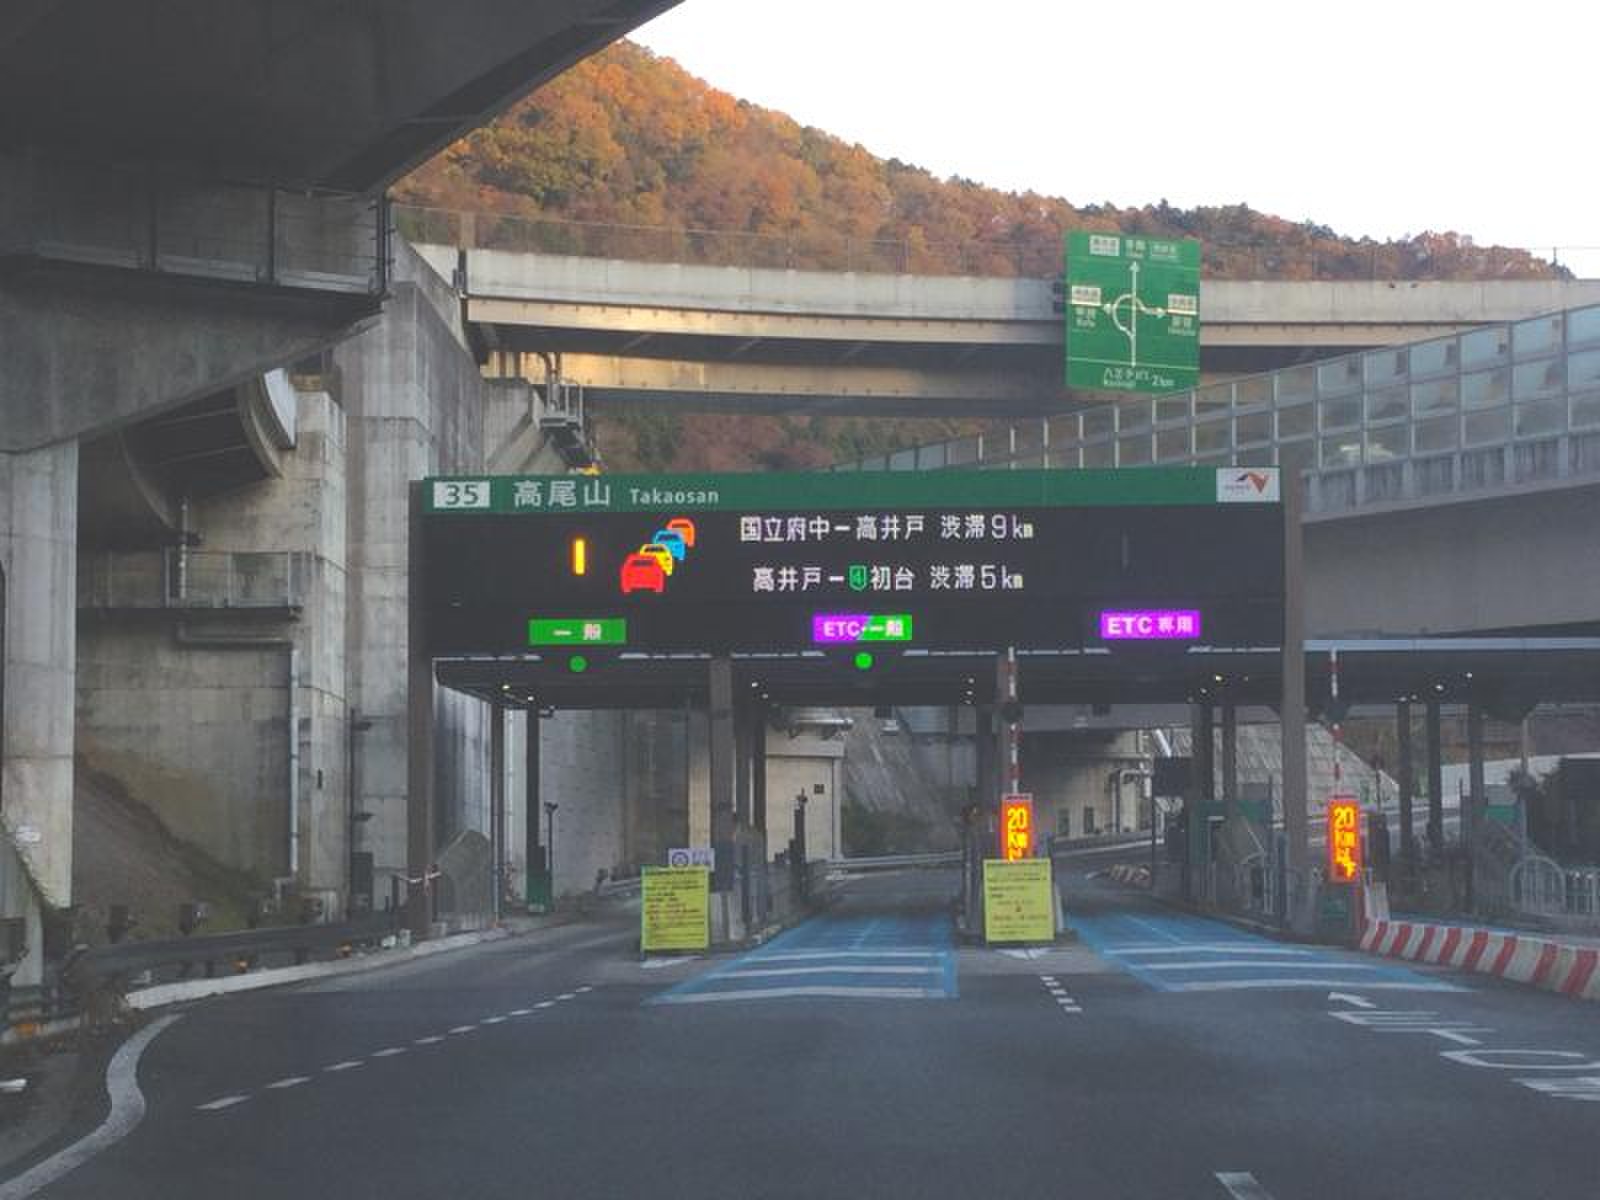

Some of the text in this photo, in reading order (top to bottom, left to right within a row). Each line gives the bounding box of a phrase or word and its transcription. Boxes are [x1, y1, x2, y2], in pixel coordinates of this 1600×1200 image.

[444, 480, 719, 507] 35 高尾山 Takaosan
[1107, 616, 1152, 635] ETC
[1007, 806, 1028, 829] 20
[1333, 806, 1355, 829] 20
